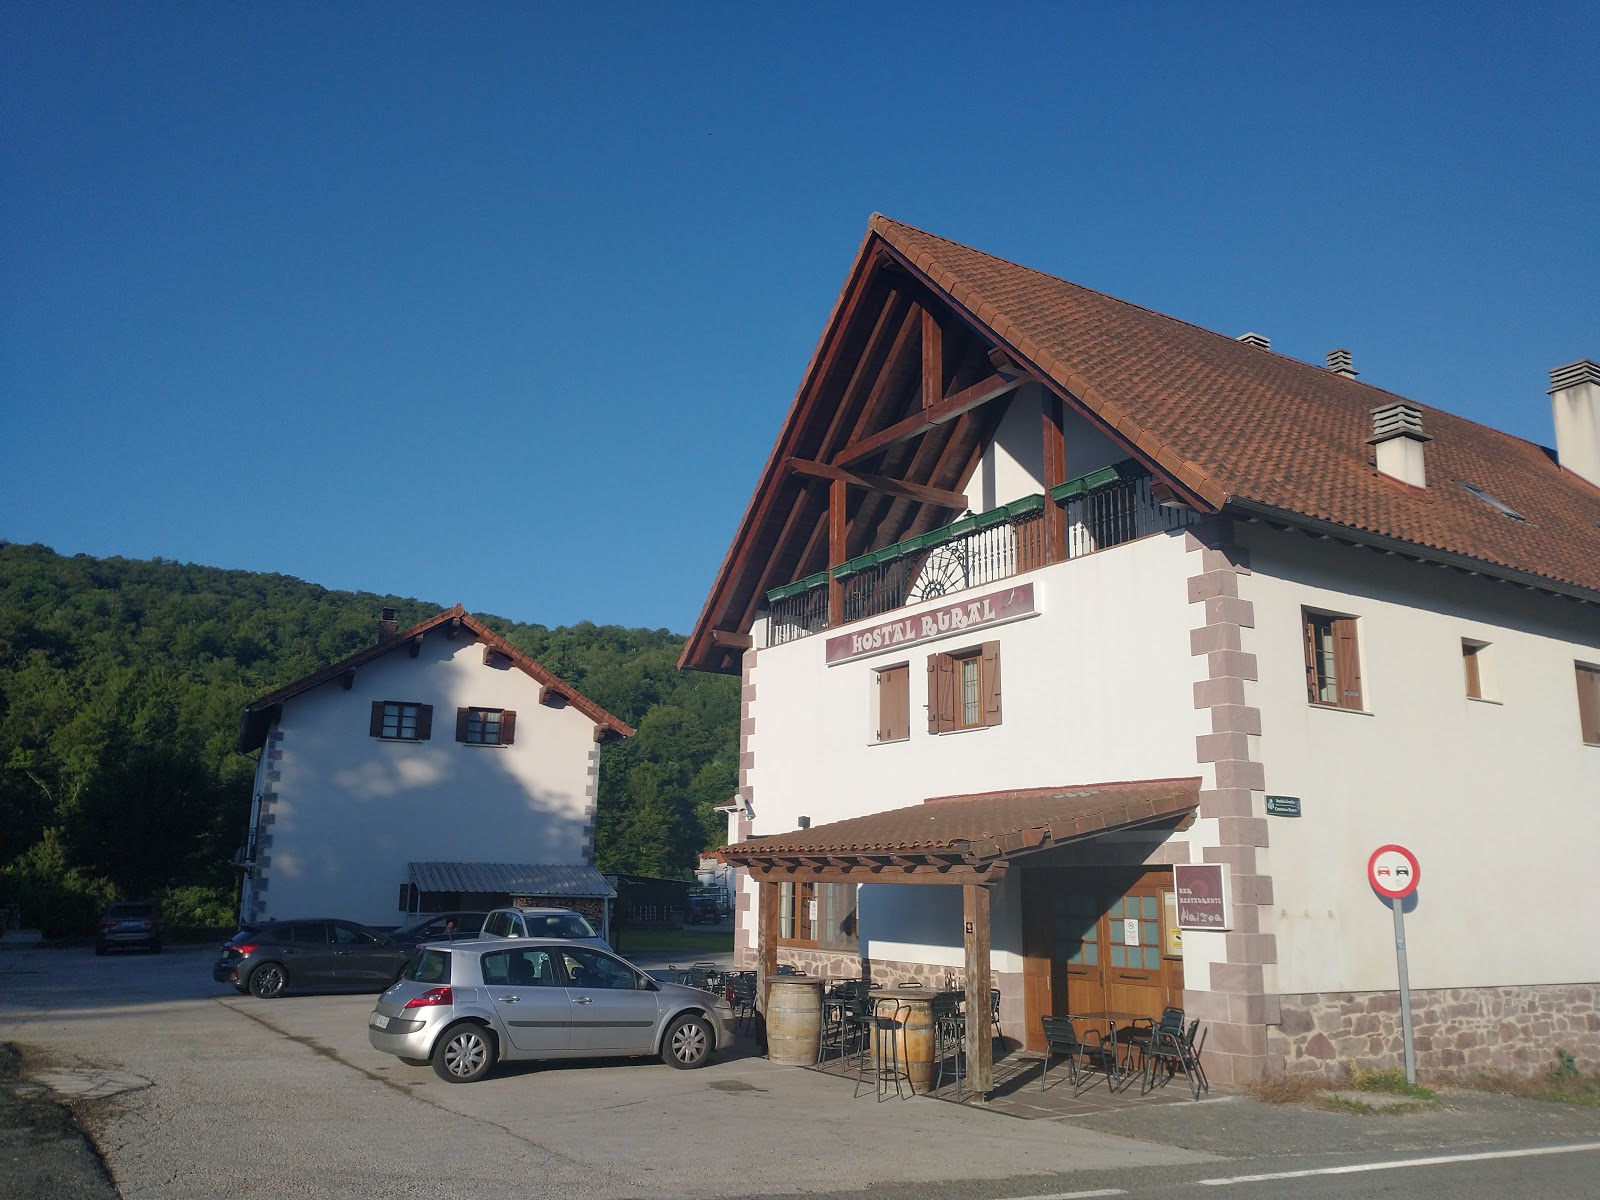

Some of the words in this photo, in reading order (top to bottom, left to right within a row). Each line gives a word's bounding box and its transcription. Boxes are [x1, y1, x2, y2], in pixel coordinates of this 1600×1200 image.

[852, 618, 915, 653] HOSTAL
[921, 599, 995, 637] RURAL
[1181, 907, 1223, 923] Haizea
